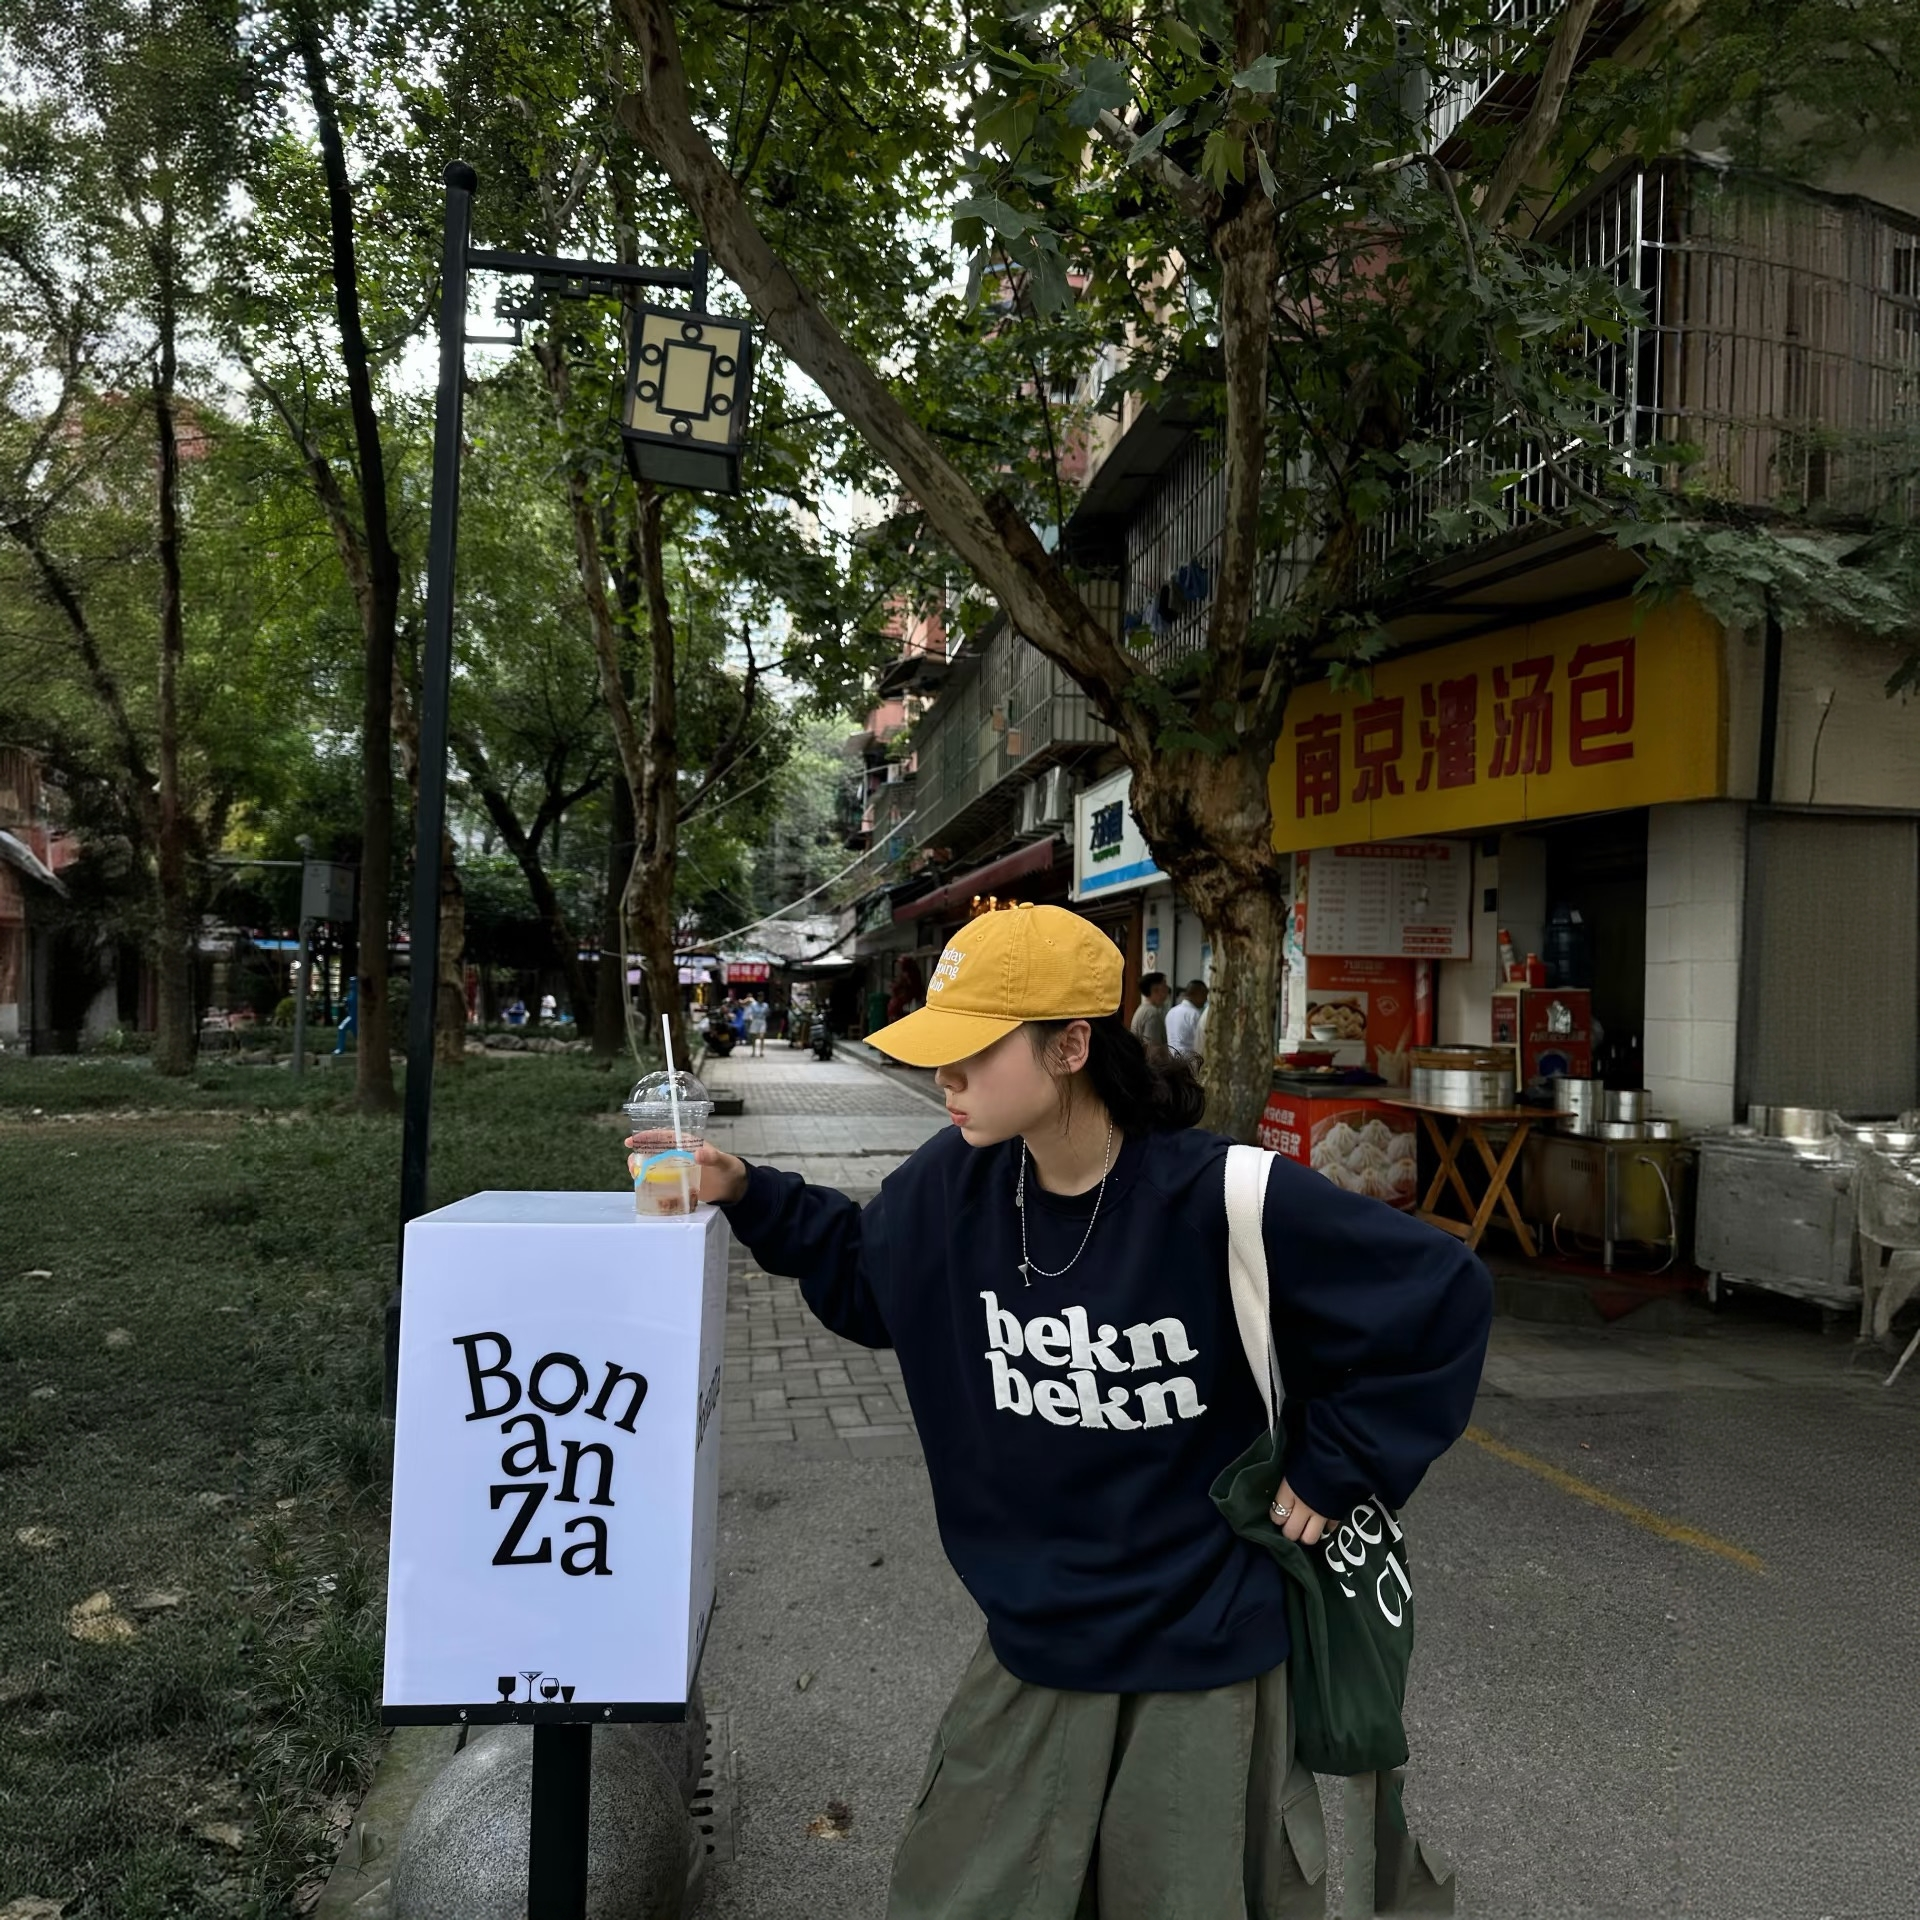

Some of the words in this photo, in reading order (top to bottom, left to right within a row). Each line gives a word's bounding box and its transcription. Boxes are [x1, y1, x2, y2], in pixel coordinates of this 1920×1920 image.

[1294, 637, 1636, 819] 南京灌汤包
[979, 1290, 1200, 1373] bekn
[452, 1331, 649, 1435] Bon
[984, 1350, 1208, 1431] bekn
[500, 1413, 616, 1507] an
